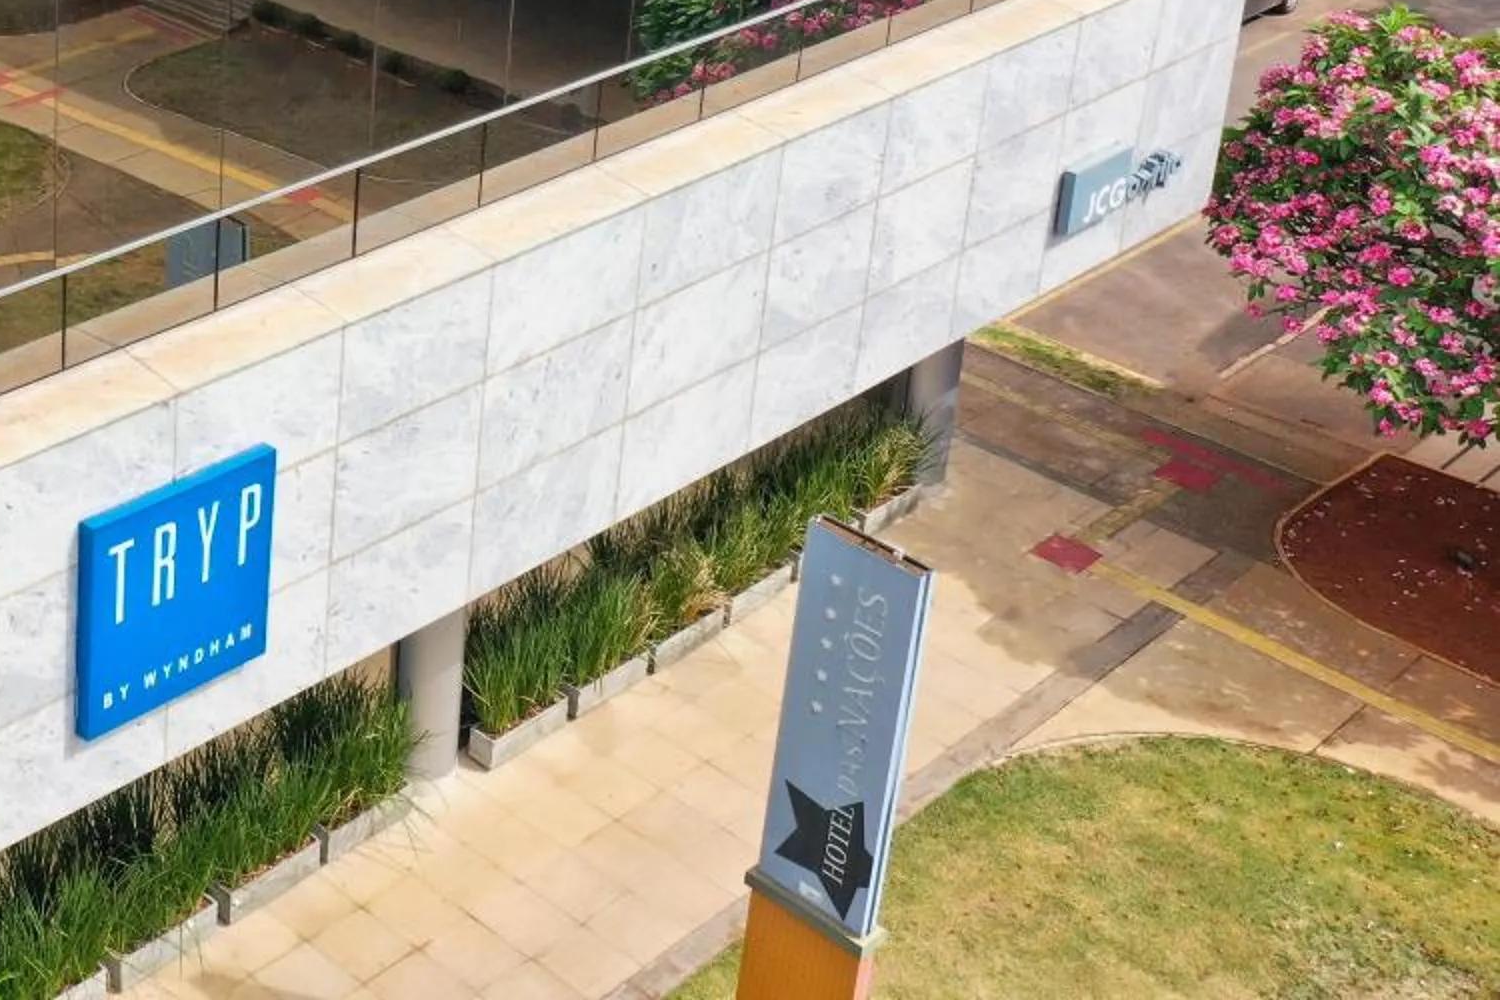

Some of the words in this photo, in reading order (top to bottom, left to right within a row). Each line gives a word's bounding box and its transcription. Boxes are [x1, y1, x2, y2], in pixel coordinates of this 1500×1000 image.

[108, 483, 262, 625] TRYP
[103, 684, 131, 709] BY
[143, 624, 252, 689] WYNDHAM
[837, 586, 888, 741] NAÇÕES
[821, 806, 855, 886] HOTEL
